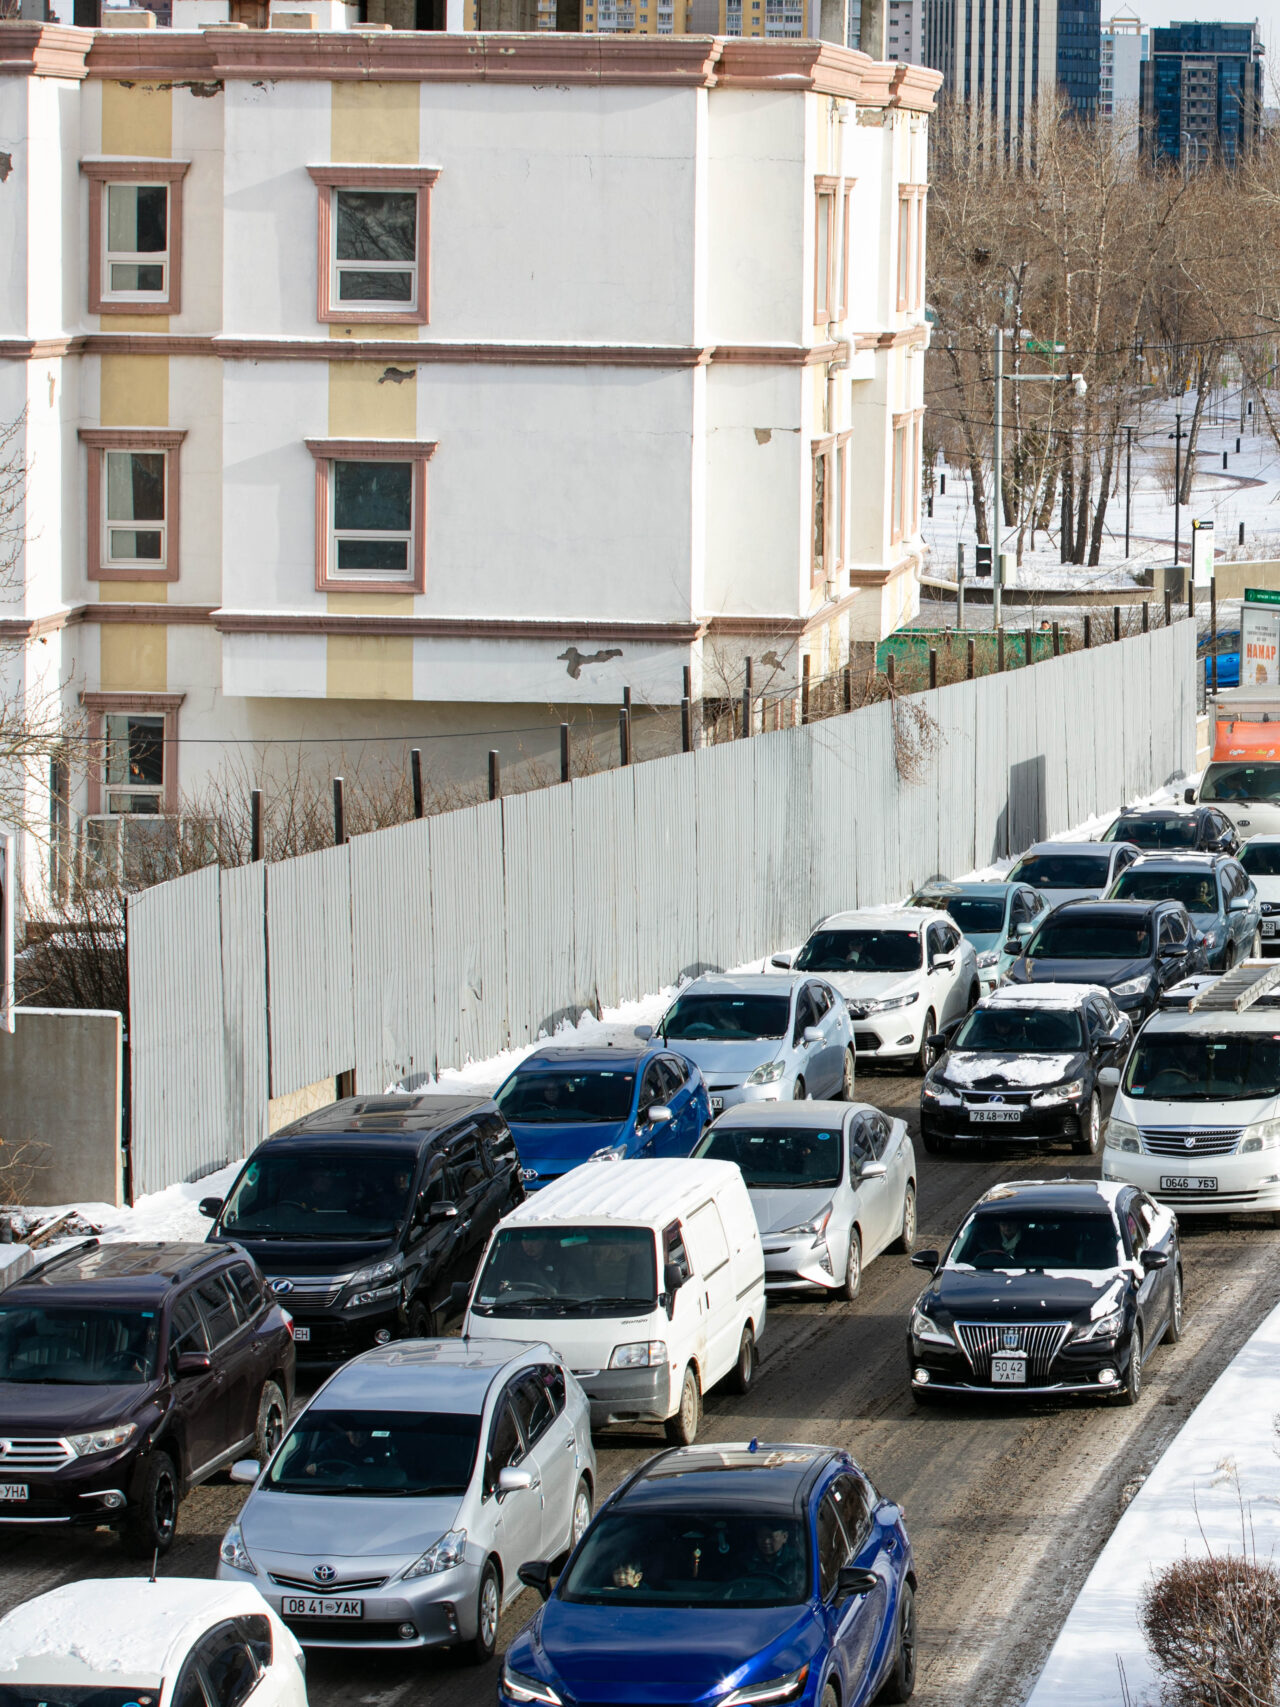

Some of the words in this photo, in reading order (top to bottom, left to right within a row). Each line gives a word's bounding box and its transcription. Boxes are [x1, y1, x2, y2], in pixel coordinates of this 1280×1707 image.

[1246, 643, 1277, 661] НАМАР
[974, 1112, 984, 1120] 78
[987, 1112, 997, 1120] 48
[1003, 1112, 1019, 1120] УКО
[1165, 1178, 1189, 1188] 0646
[995, 1362, 1008, 1372] 50
[1010, 1362, 1023, 1372] 42
[4, 1485, 26, 1497] УНА
[289, 1599, 305, 1613] 08
[309, 1600, 323, 1614] 41
[335, 1602, 359, 1614] УАК
